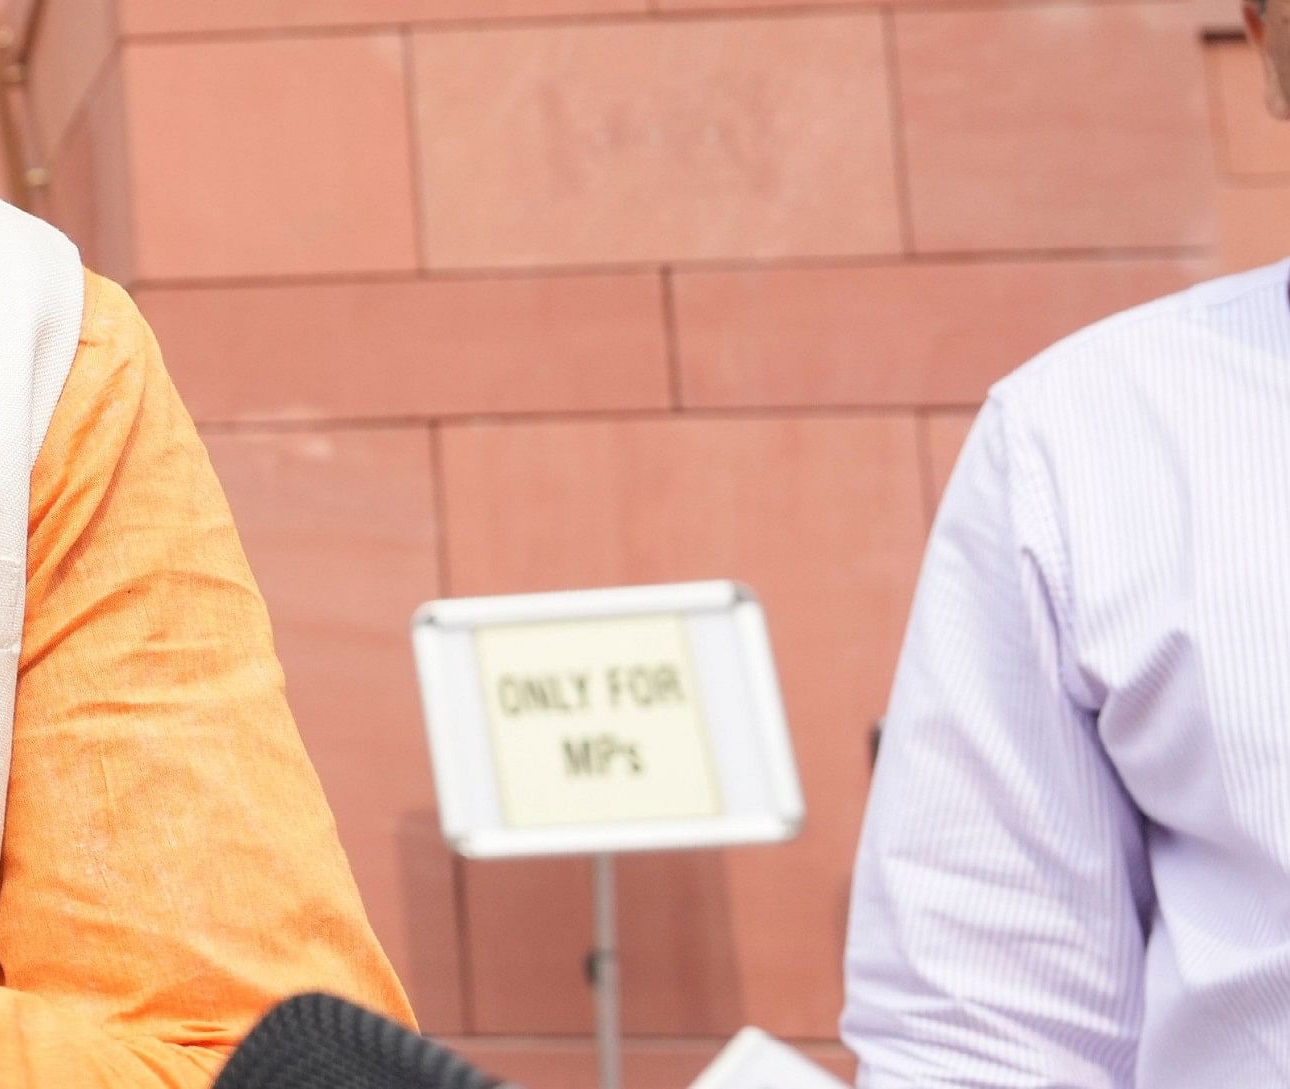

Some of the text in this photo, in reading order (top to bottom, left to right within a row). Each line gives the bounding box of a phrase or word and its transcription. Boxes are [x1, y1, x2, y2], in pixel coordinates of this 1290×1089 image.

[497, 662, 685, 719] ONLY FOR
[561, 731, 644, 779] MPs
